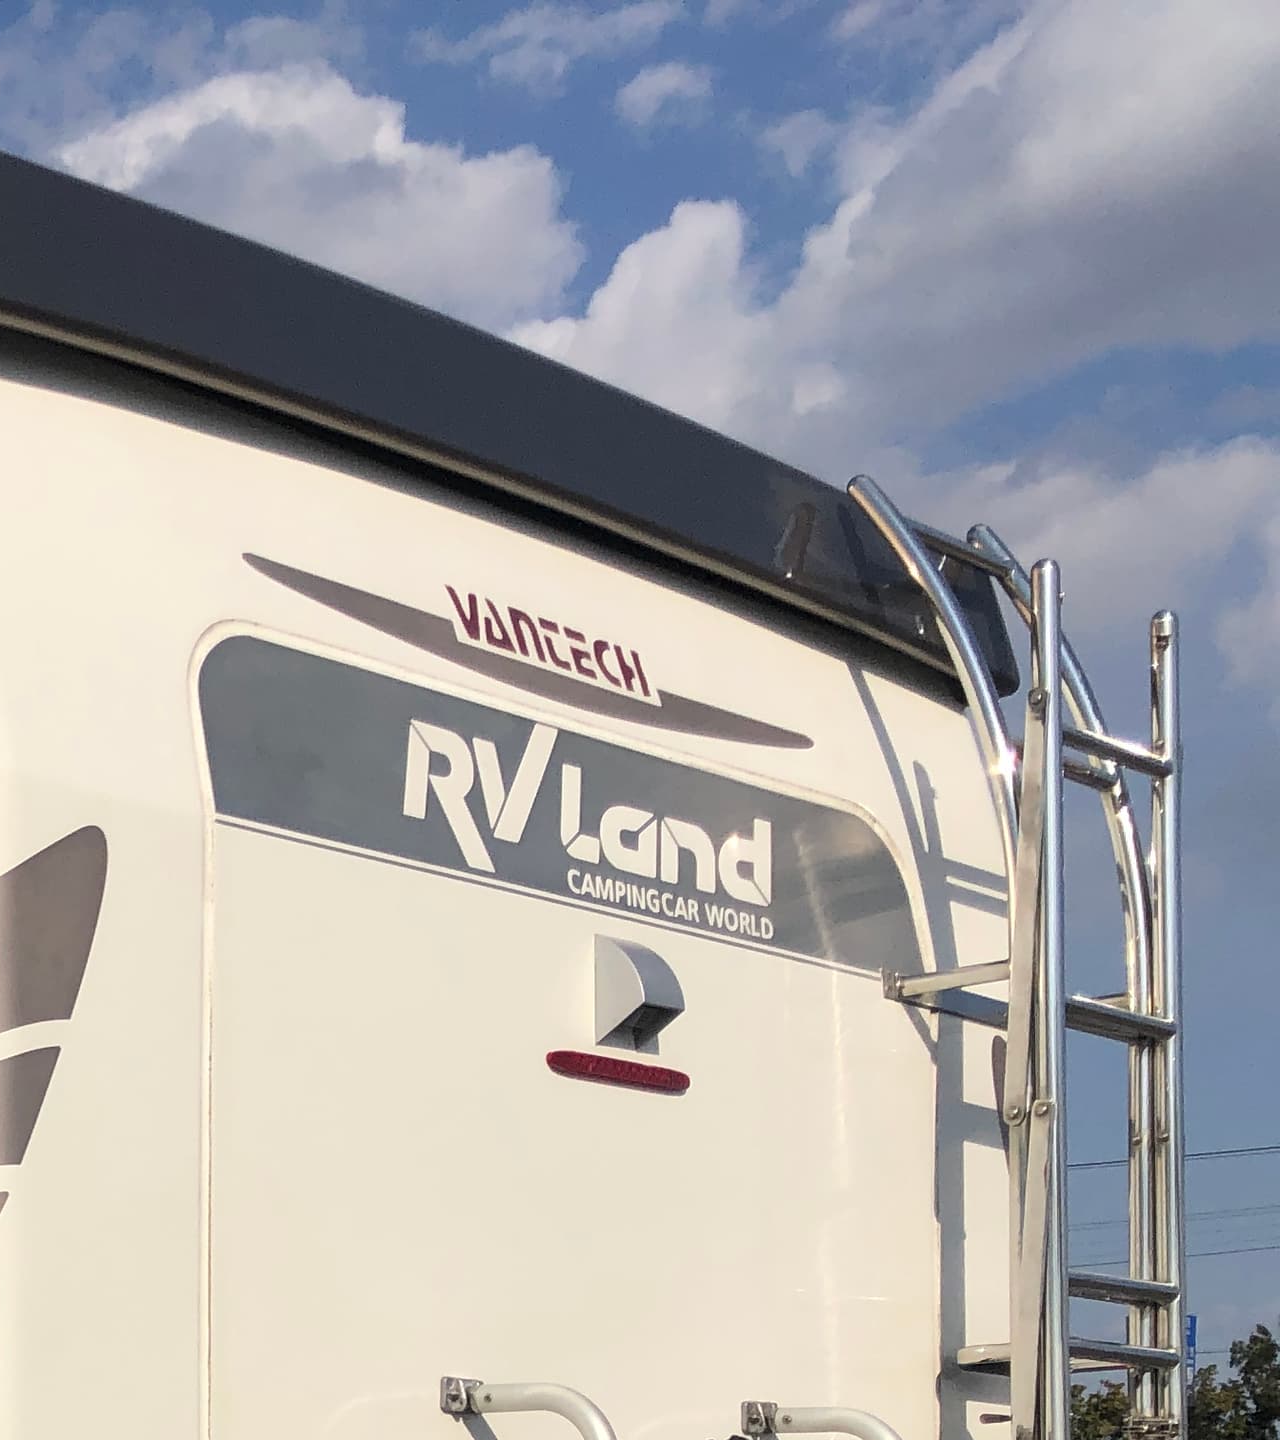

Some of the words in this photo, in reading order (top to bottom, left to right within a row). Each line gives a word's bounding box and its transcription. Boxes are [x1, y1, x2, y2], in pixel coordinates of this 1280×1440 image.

[444, 583, 652, 698] VANTECH
[402, 719, 559, 874] RV
[704, 901, 775, 940] WORLD
